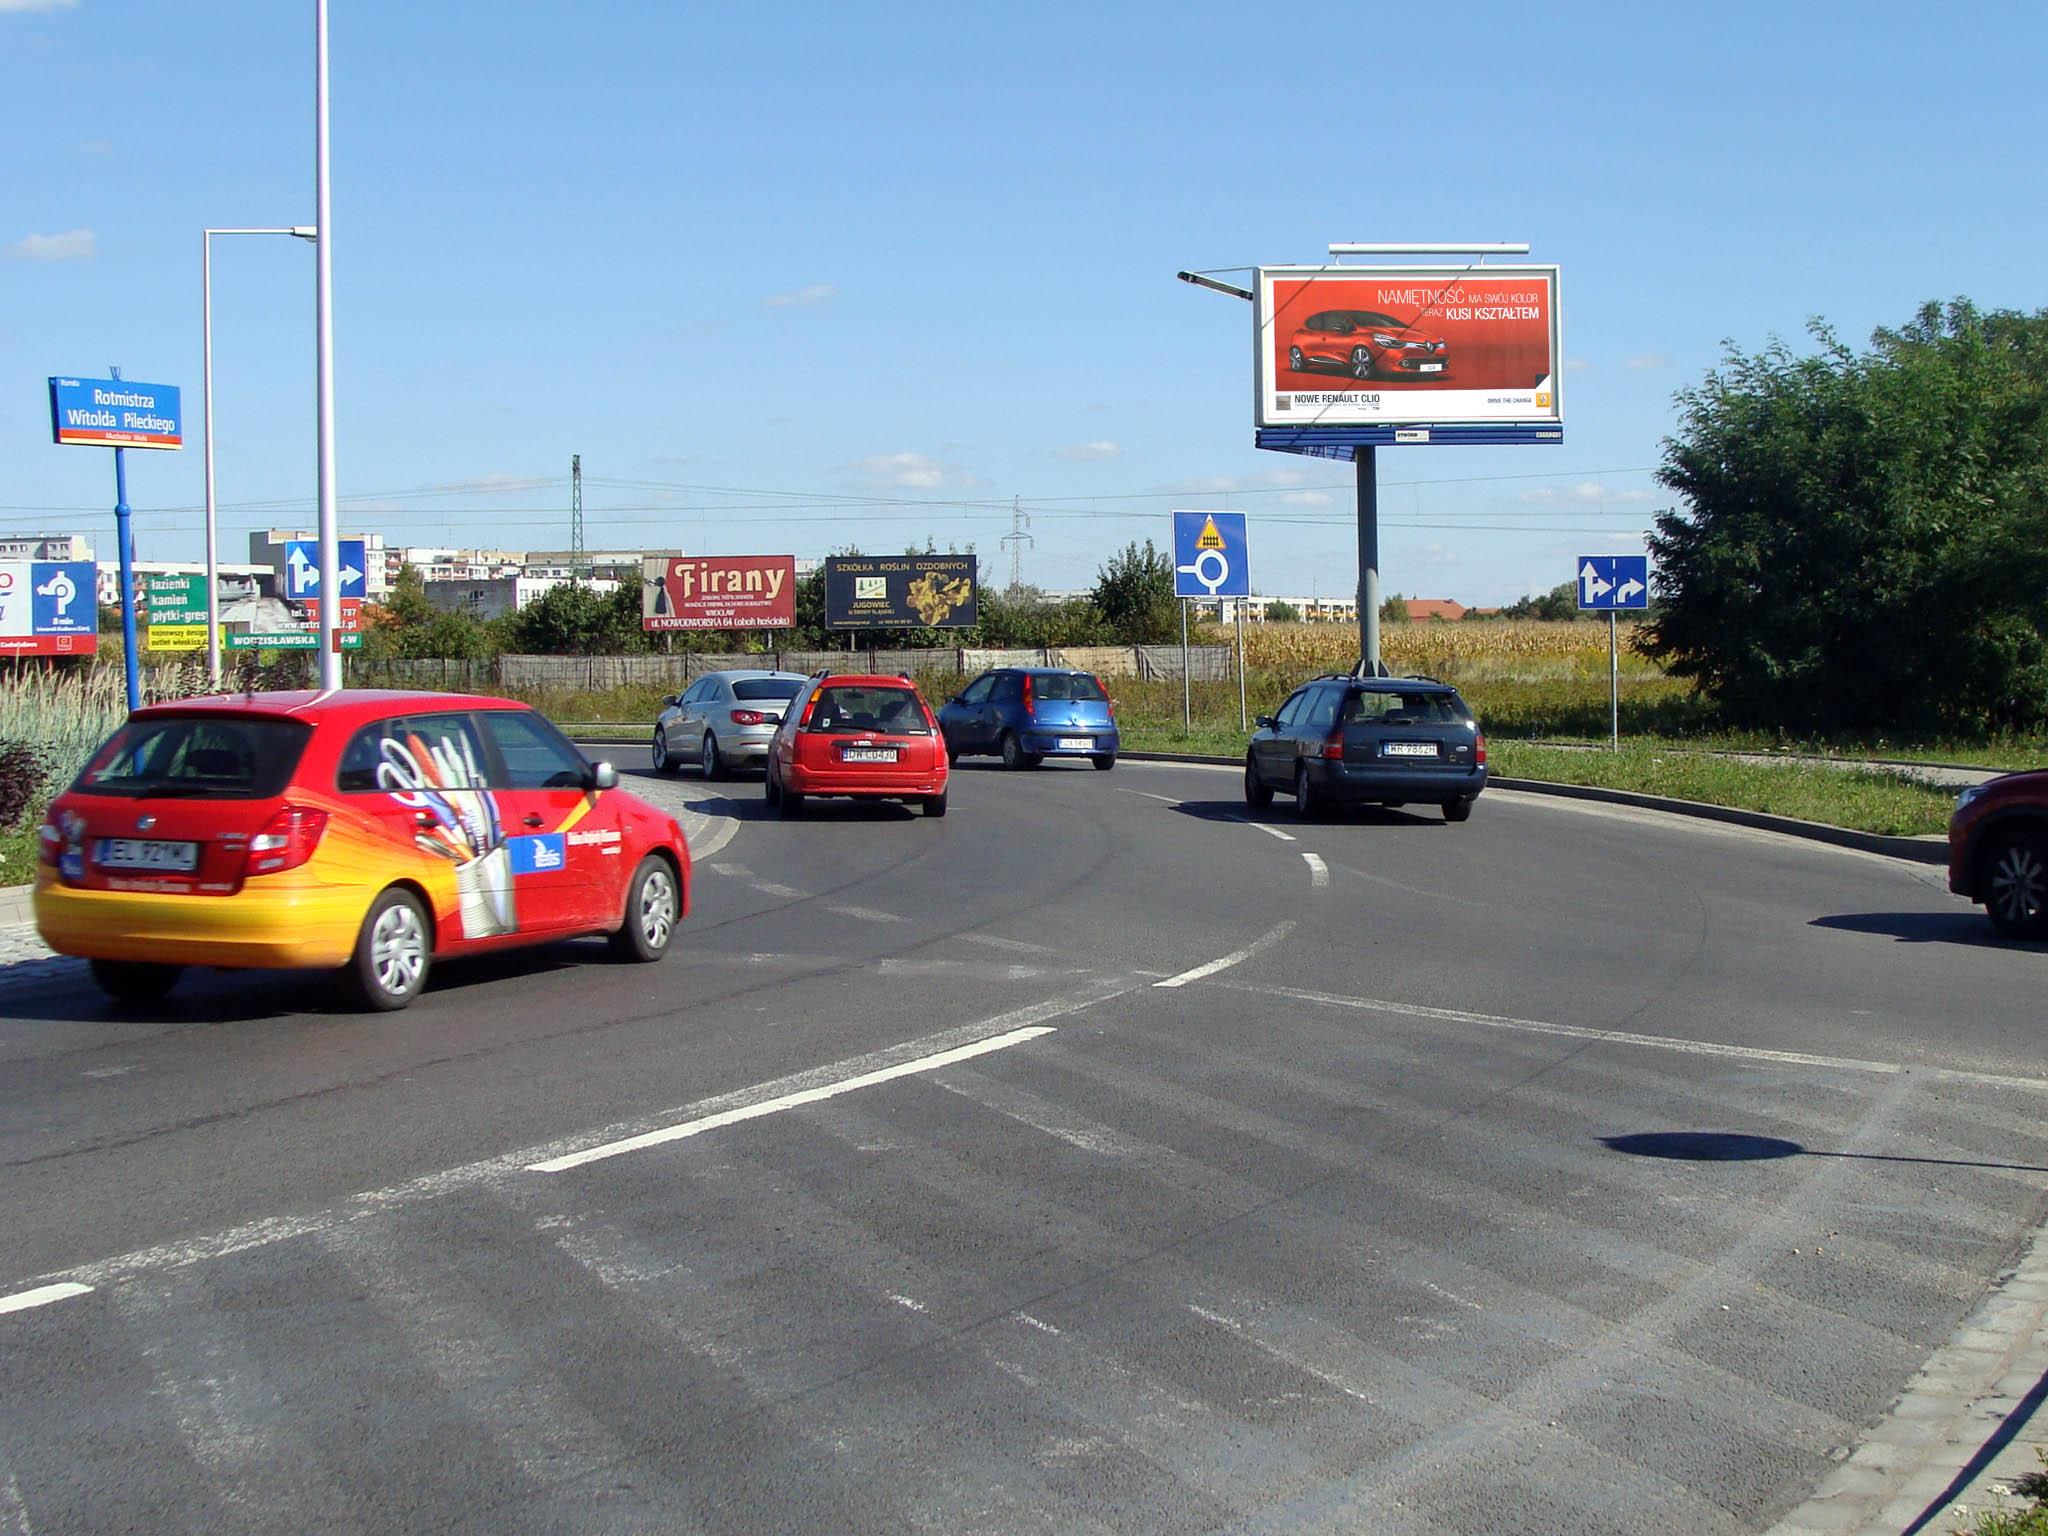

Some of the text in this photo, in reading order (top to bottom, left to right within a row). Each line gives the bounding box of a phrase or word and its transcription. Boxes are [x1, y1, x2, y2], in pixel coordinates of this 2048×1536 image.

[1377, 286, 1539, 307] NAMIĘTNOŚĆ MA SWÓJ KOLOR
[1446, 308, 1472, 320] KUSI
[1474, 307, 1539, 319] KSZTAŁTEM
[94, 389, 154, 408] Rotmistrza
[1294, 394, 1380, 403] NOWE RENAULT CLIO
[67, 409, 175, 434] Witolda Pileckiego
[836, 561, 968, 572] SZKÓŁKA ROŚLIN OZDOBNYCH
[151, 578, 190, 590] łazienki
[675, 562, 785, 599] Firany
[152, 593, 188, 606] kamień
[233, 635, 316, 646] WODZISŁAWSKA
